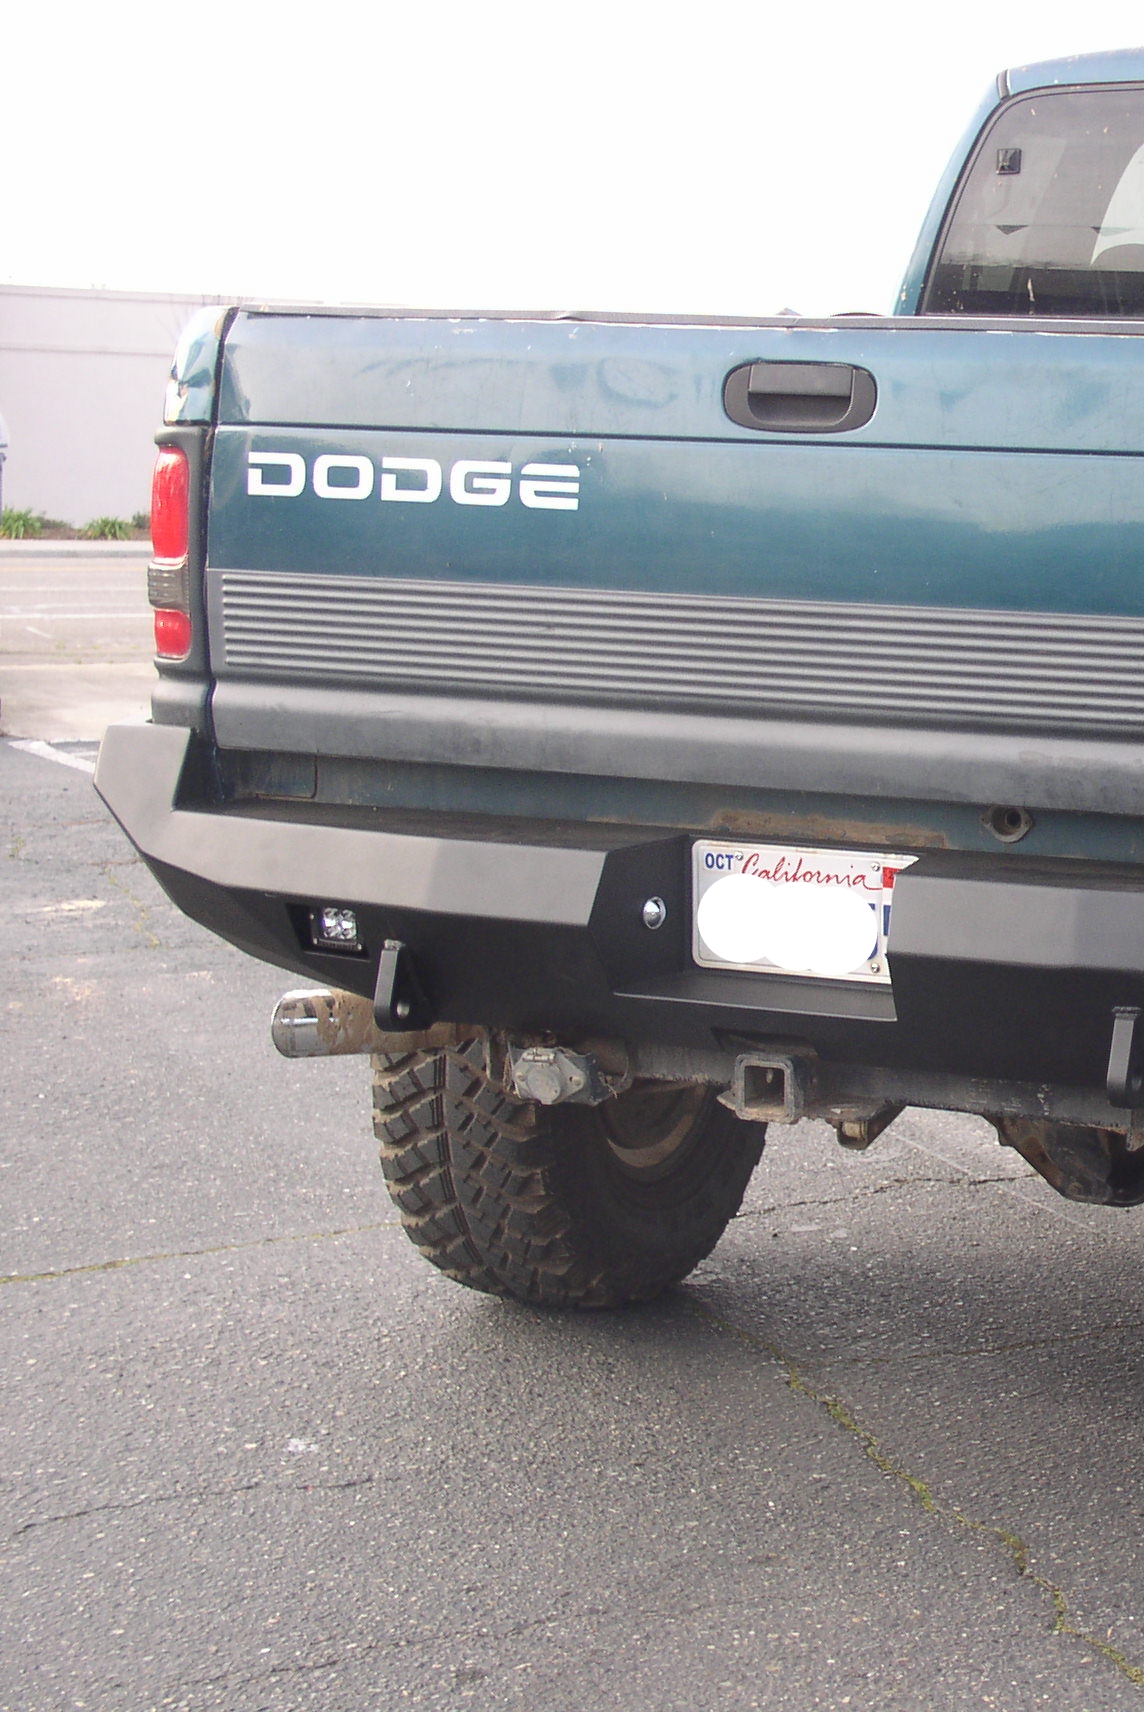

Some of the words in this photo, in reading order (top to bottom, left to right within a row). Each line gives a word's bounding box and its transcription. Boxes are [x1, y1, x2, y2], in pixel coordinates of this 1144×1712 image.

[247, 451, 580, 511] DODGE
[704, 852, 734, 871] OCT
[741, 852, 883, 891] California
